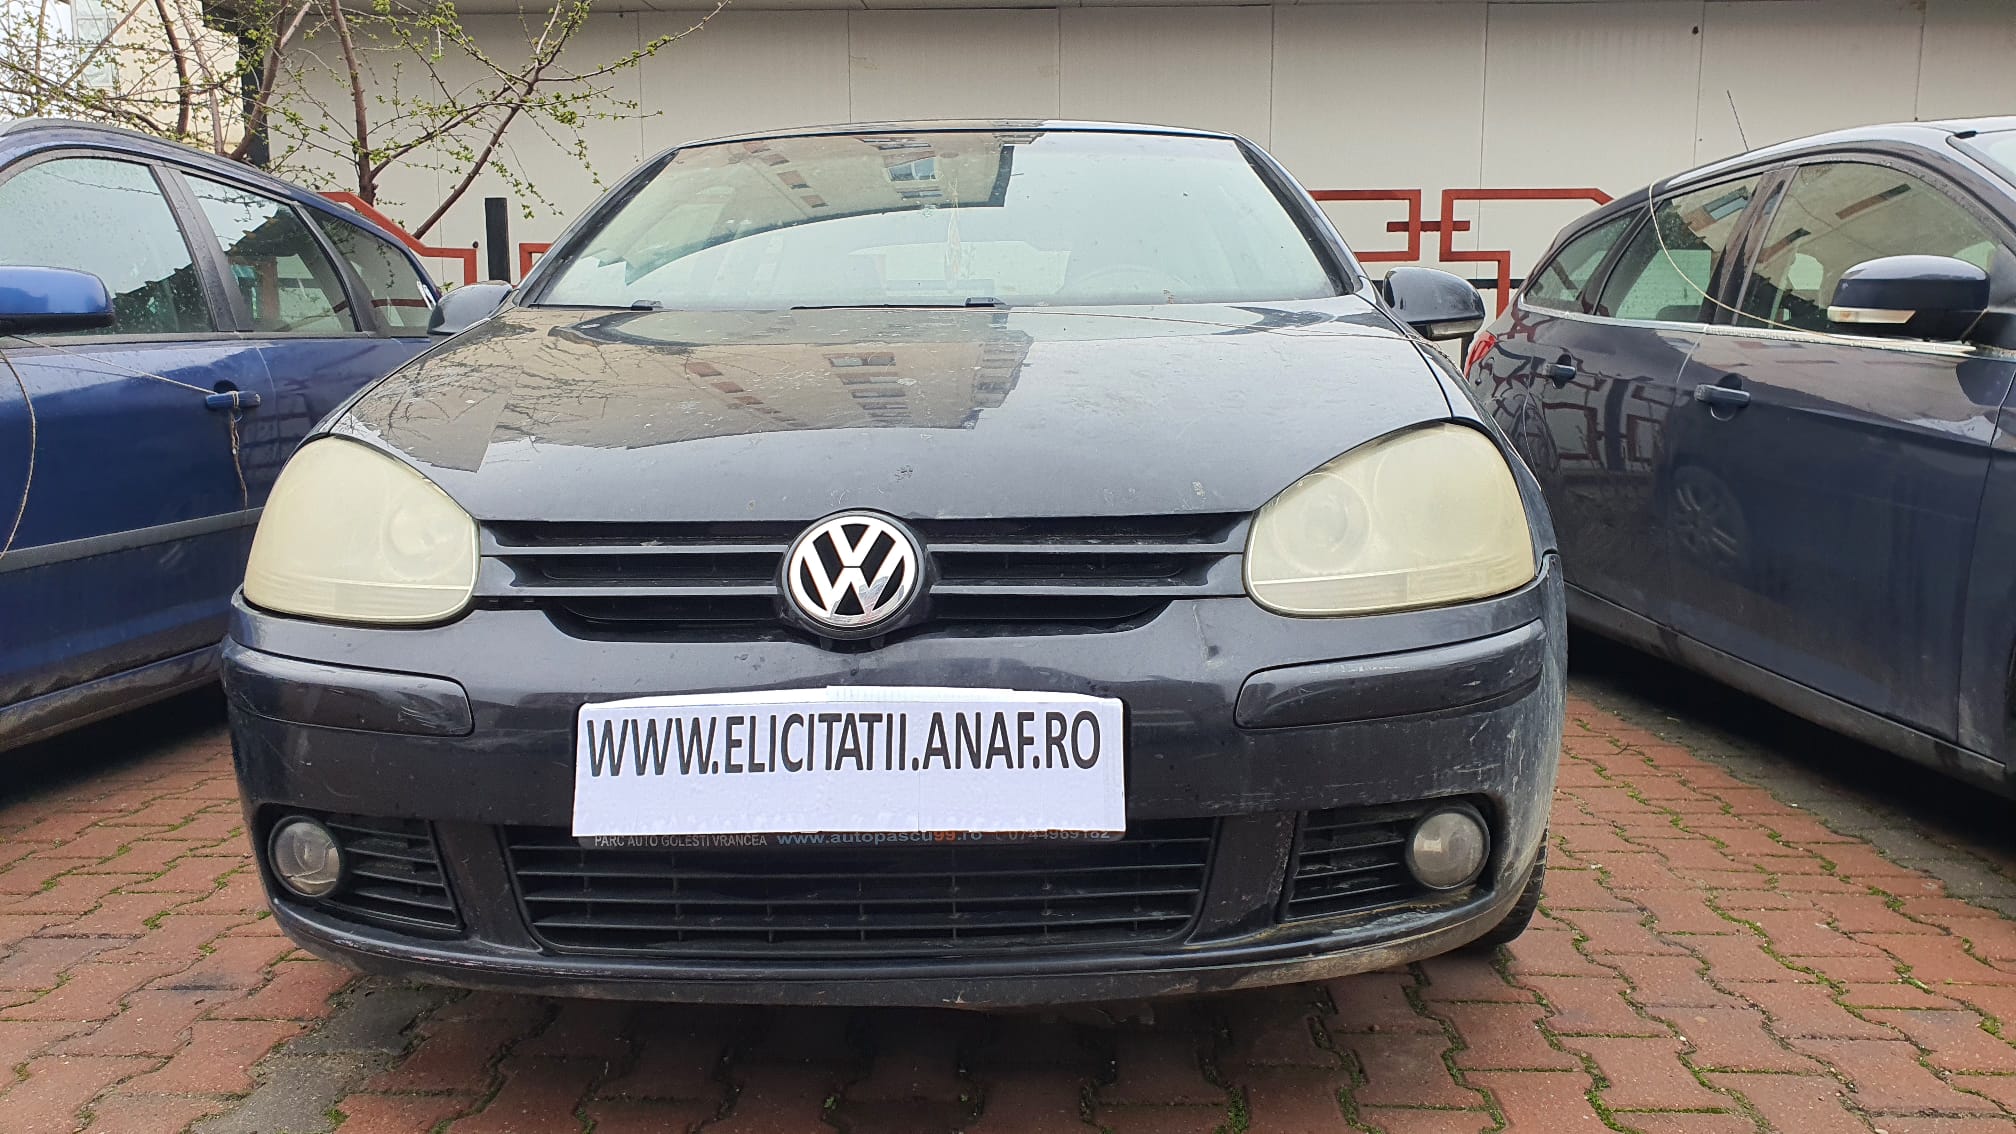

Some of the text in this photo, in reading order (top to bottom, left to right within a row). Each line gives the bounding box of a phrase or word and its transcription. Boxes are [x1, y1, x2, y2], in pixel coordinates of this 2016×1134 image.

[788, 515, 915, 626] VW
[587, 710, 1102, 777] WWW.ELICITATII.ANAF.RO
[594, 834, 768, 847] PARC AUTO GOLESTI VRANCEA
[776, 830, 984, 845] www.autopascu99.ro
